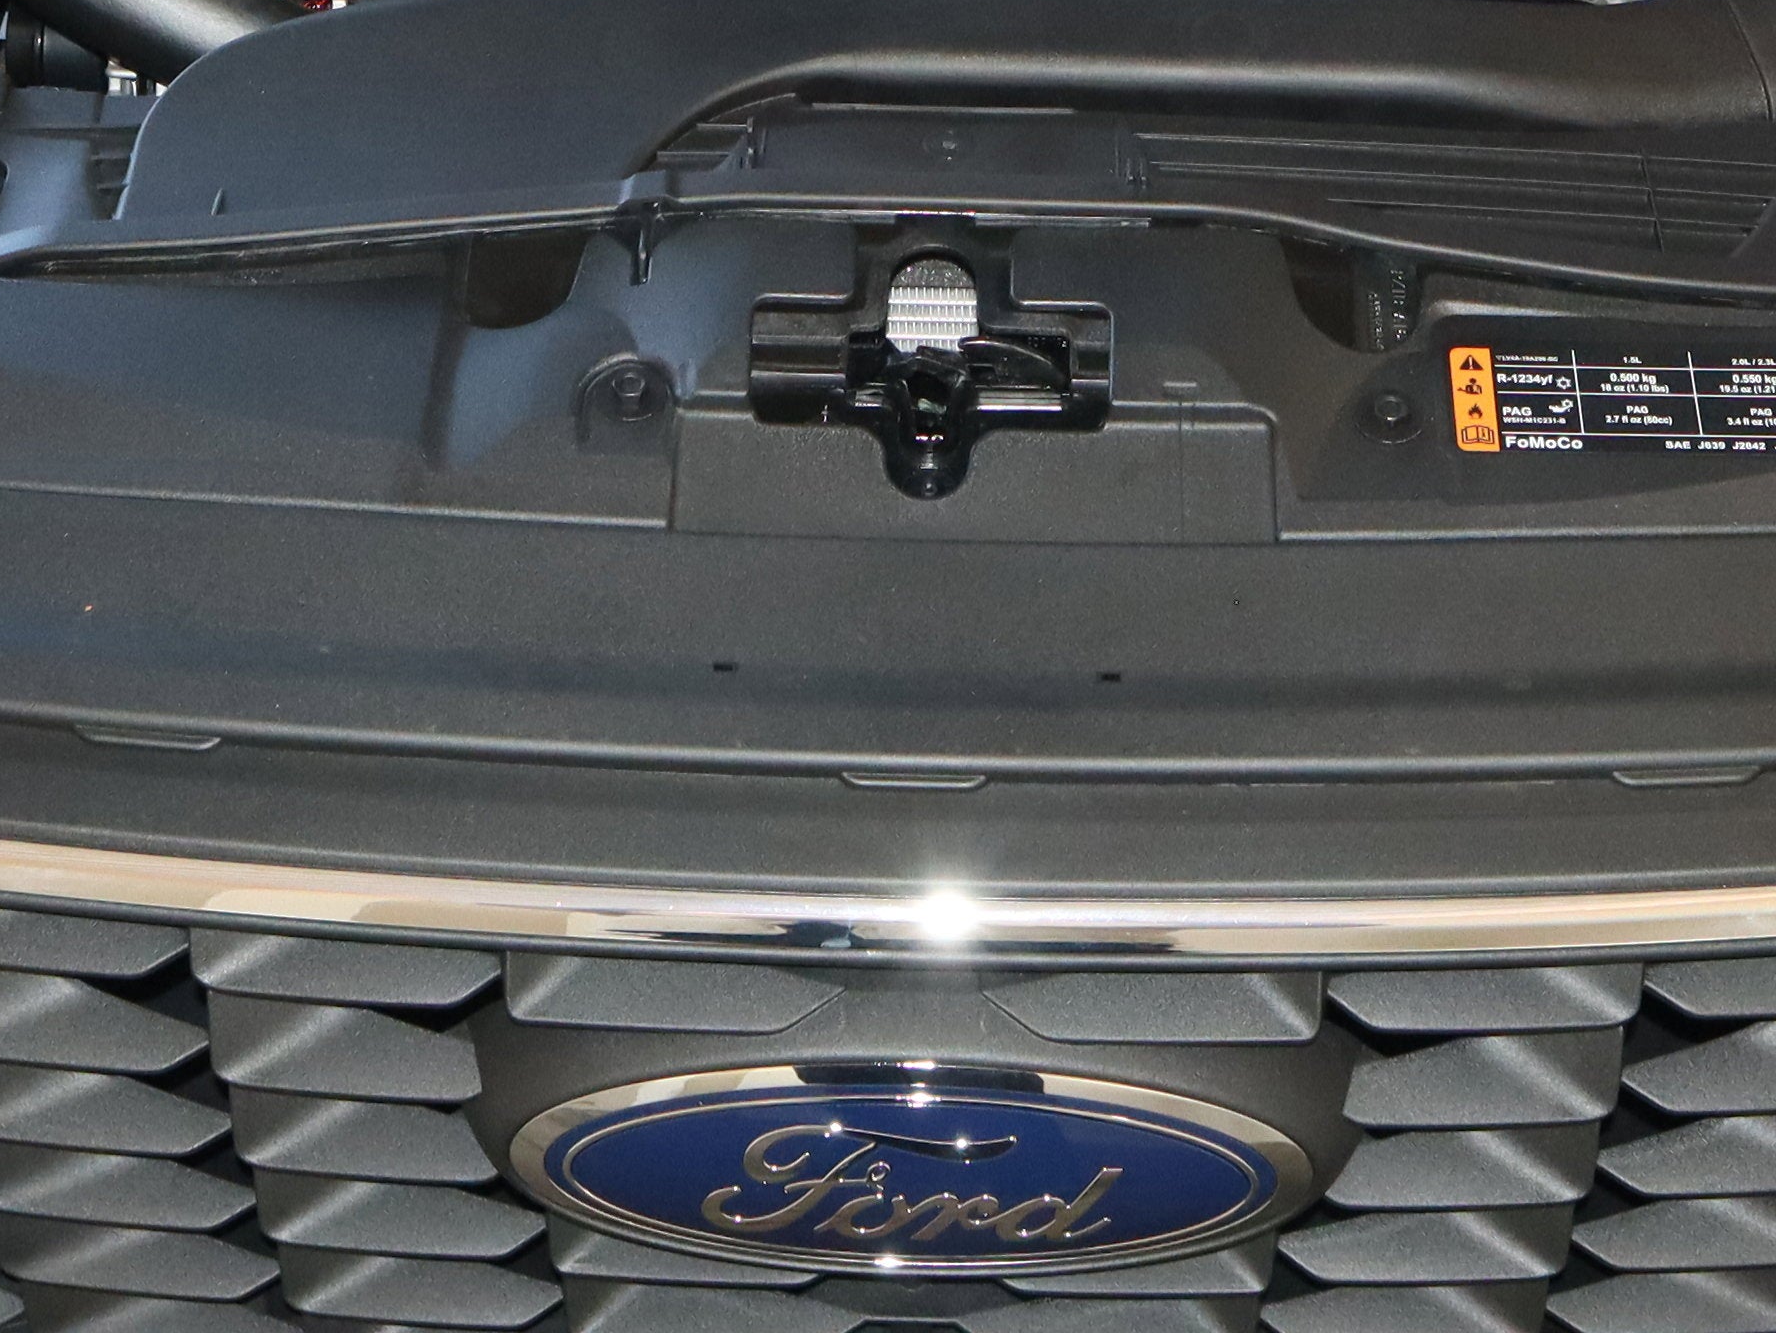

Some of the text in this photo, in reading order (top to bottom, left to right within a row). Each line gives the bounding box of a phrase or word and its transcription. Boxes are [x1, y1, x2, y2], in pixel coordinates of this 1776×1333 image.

[1623, 356, 1642, 364] 1.5L
[1731, 358, 1751, 366] 2.0L
[1496, 373, 1553, 385] R-1234yf
[1609, 373, 1657, 385] 0.500 kg
[1732, 374, 1762, 383] 0.550
[1613, 384, 1625, 392] oz
[1627, 383, 1650, 393] (1.10
[1651, 384, 1670, 394] lbs)
[1754, 385, 1776, 395] (1.21
[1502, 406, 1532, 416] PAG
[1605, 415, 1620, 424] 2.7
[1621, 415, 1629, 424] fl
[1630, 416, 1642, 424] oz
[1726, 417, 1741, 426] 3.4
[1742, 417, 1750, 426] fl
[1751, 418, 1764, 426] oz
[1505, 436, 1583, 450] FoMoCo
[1665, 440, 1691, 450] SAE
[700, 1122, 1124, 1244] Ford
